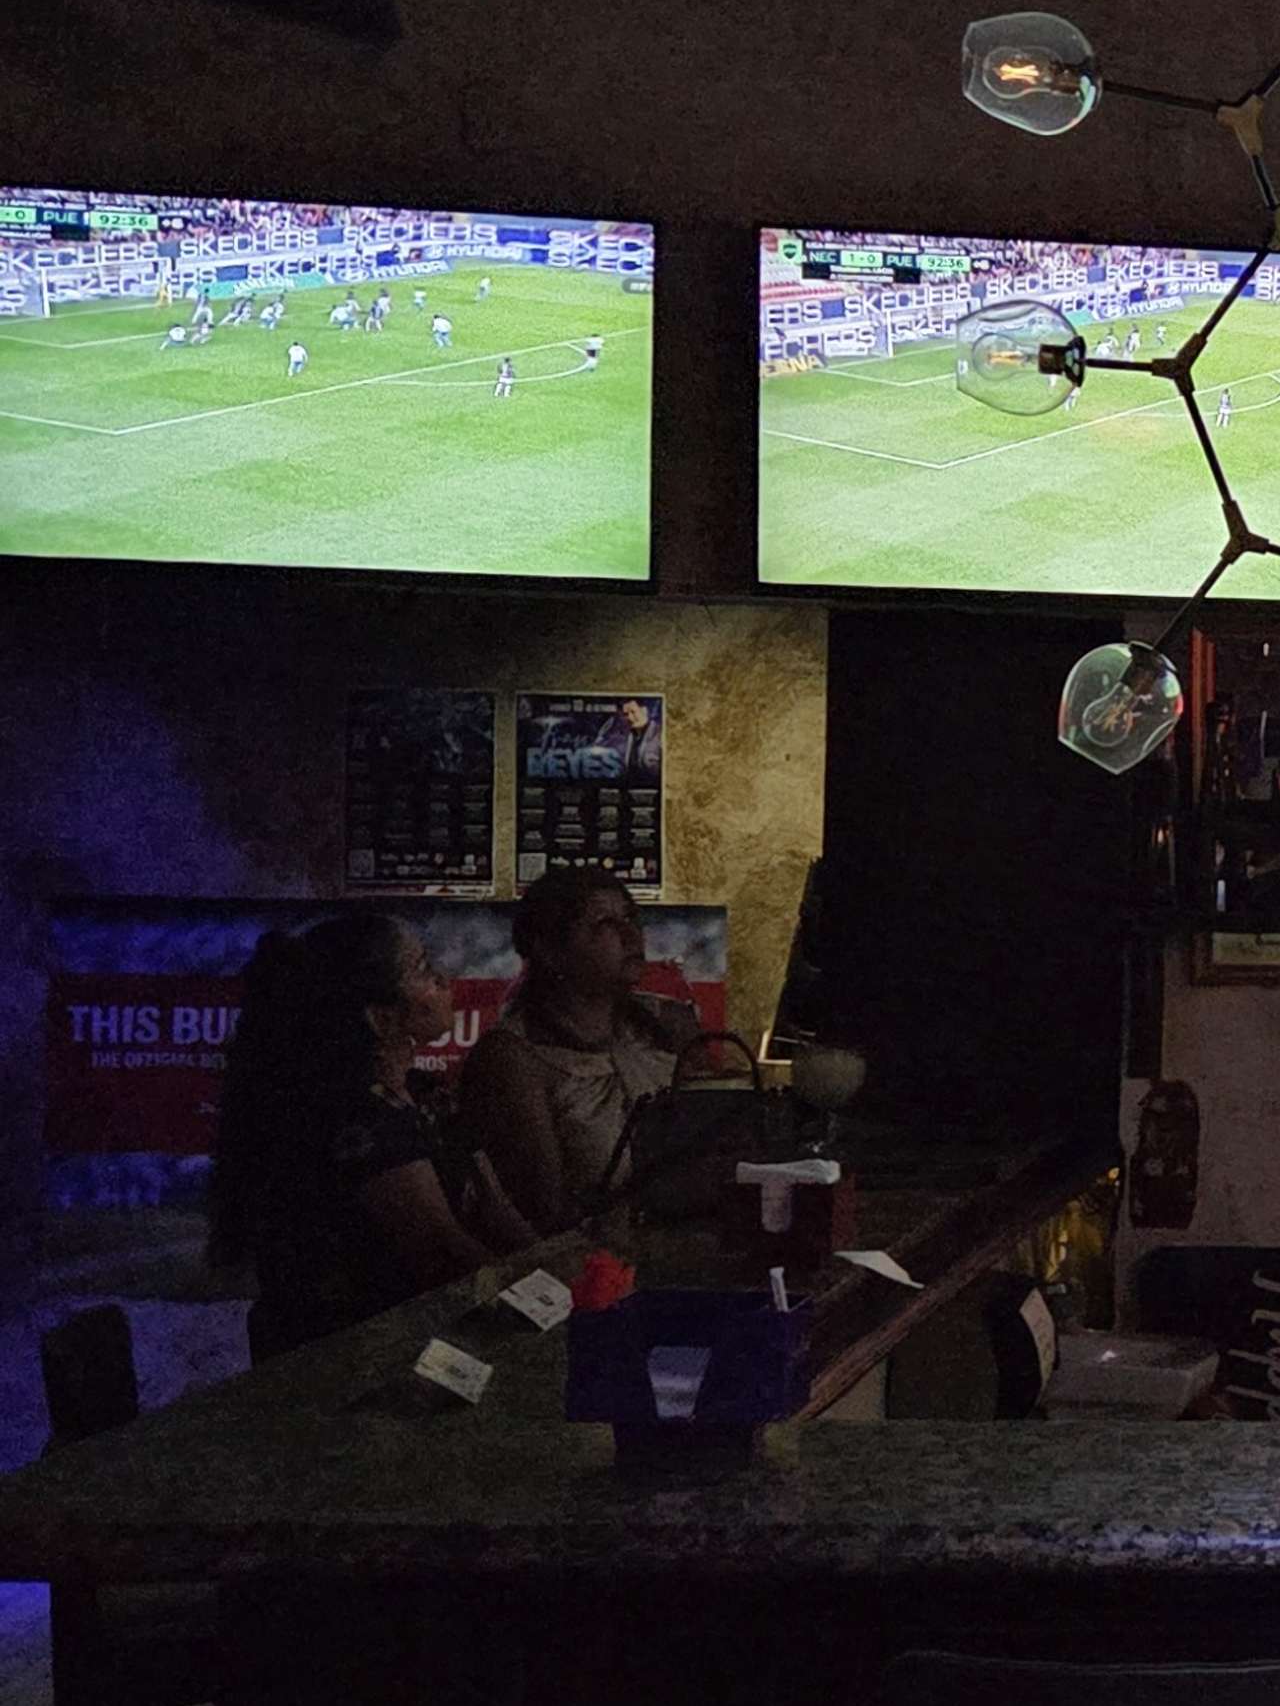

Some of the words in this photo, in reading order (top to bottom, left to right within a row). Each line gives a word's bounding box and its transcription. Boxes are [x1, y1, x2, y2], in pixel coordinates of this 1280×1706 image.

[43, 210, 78, 224] PUE
[99, 214, 149, 228] 92:36
[180, 226, 319, 259] SKECHERS
[343, 222, 499, 244] SKECHERS
[549, 230, 653, 258] SKEC
[248, 249, 378, 282] SKECHERS
[547, 246, 653, 274] SKEC
[809, 251, 837, 265] NEC
[886, 254, 914, 268] PUE
[927, 256, 965, 270] 92:36
[843, 283, 972, 318] SKECHERS
[985, 267, 1087, 297] SKECHERS
[1105, 260, 1219, 283] SKECHERS
[66, 1005, 161, 1044] THIS
[91, 1051, 121, 1070] THE
